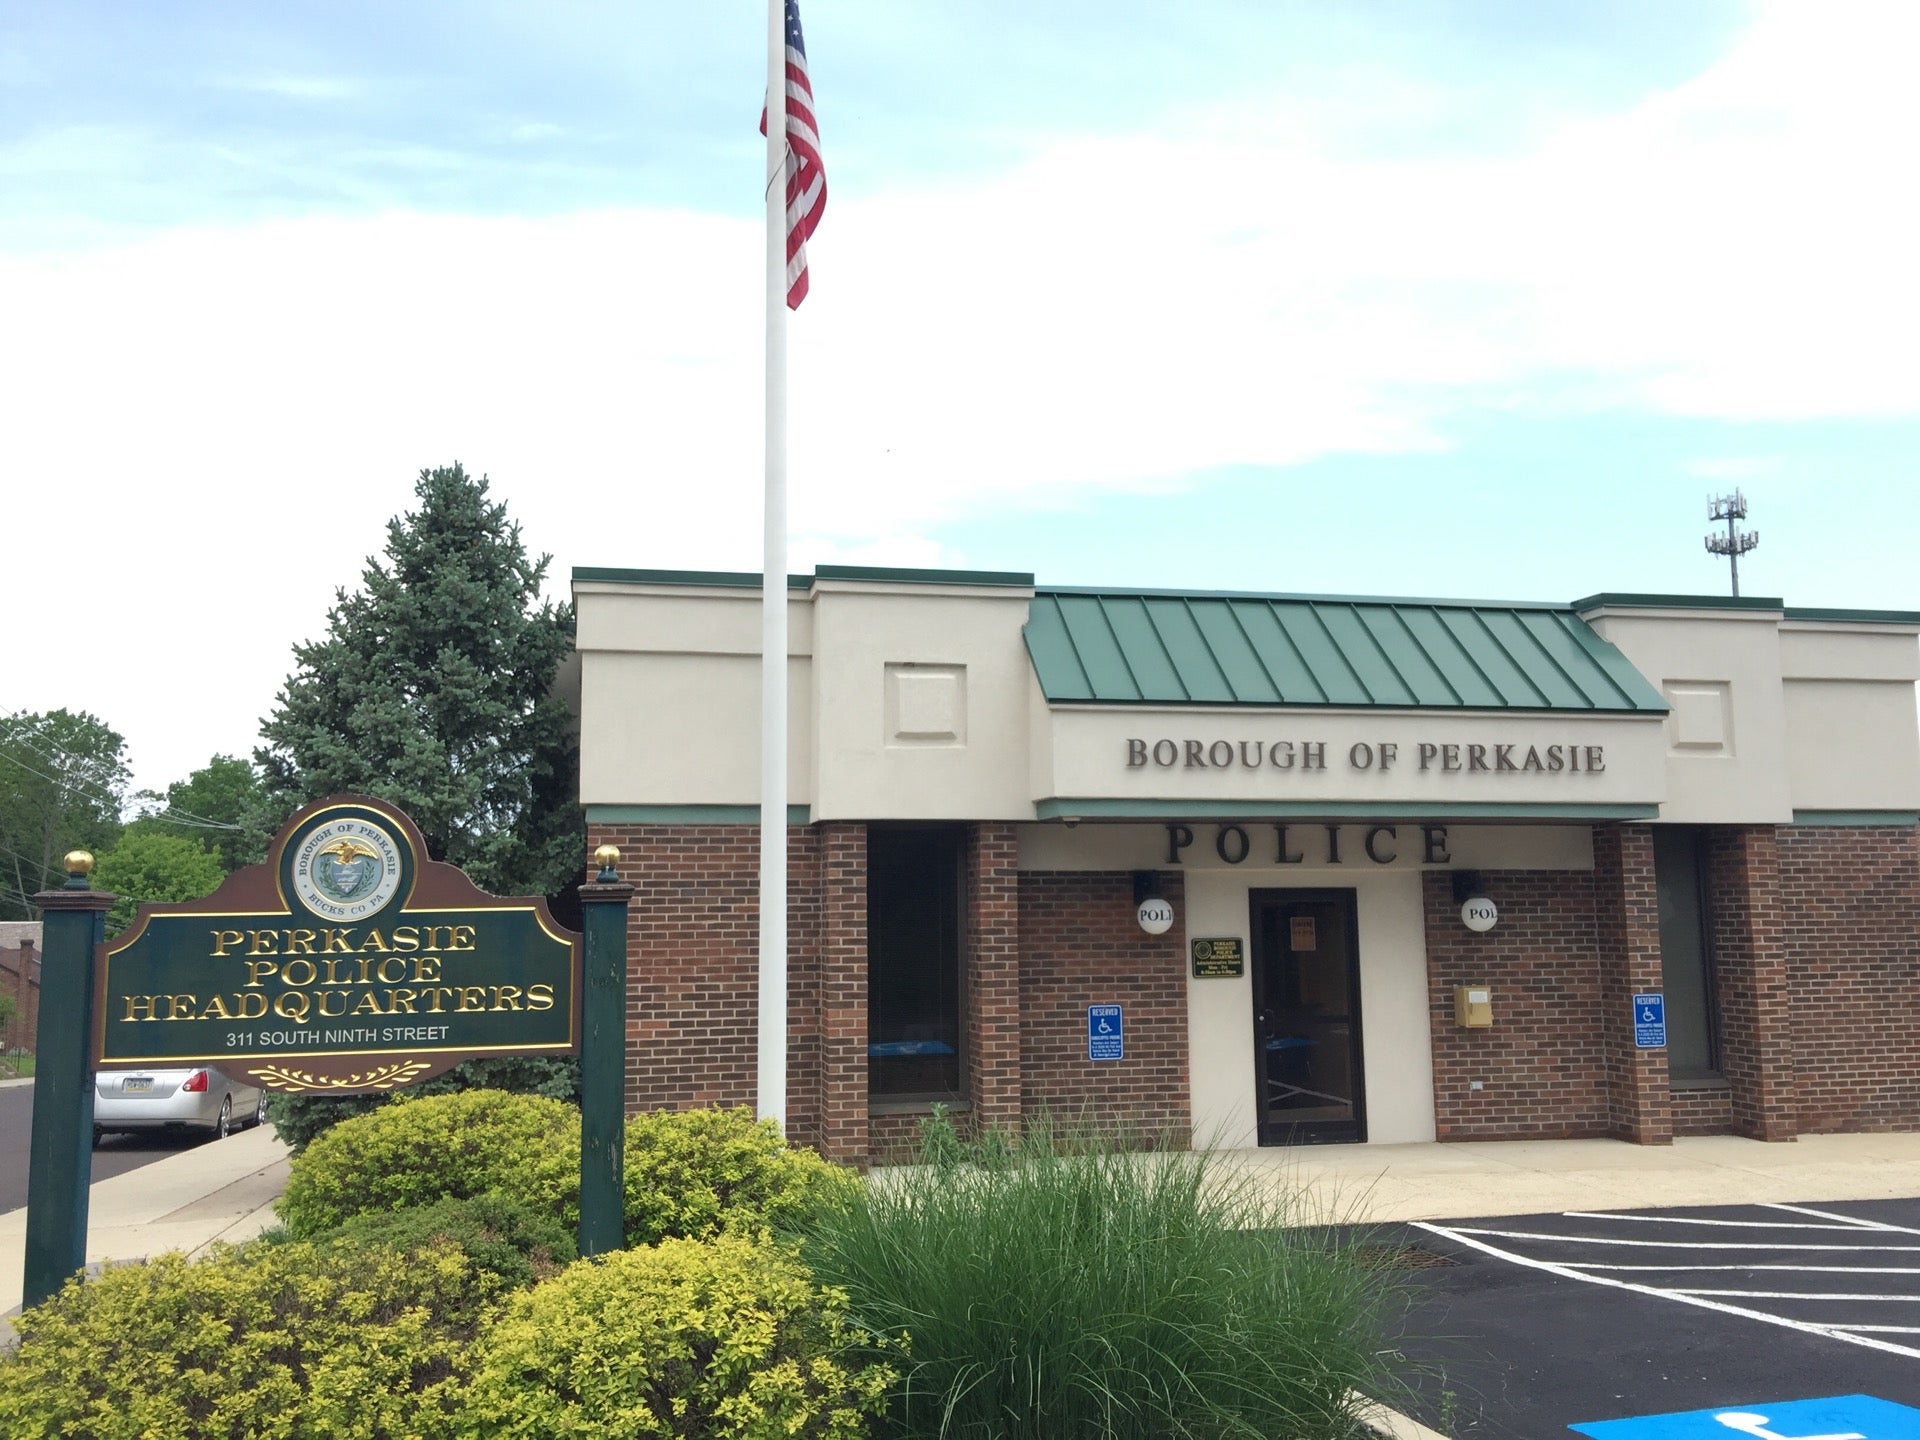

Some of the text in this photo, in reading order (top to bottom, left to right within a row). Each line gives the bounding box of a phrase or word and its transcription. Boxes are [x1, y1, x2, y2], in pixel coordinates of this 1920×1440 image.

[1125, 738, 1606, 773] BOROUGH OF PERKASIE
[299, 824, 396, 876] BOROUGH OF PERKASIE
[1163, 824, 1452, 866] POLICE
[308, 893, 384, 915] BUCKS CO PA
[209, 924, 476, 957] PERKASIE
[243, 956, 442, 988] POLICE
[120, 983, 555, 1024] HEADQUARTERS
[1092, 1008, 1119, 1017] RESERVED
[226, 1025, 450, 1047] 311 SOUTH NINTH STREET
